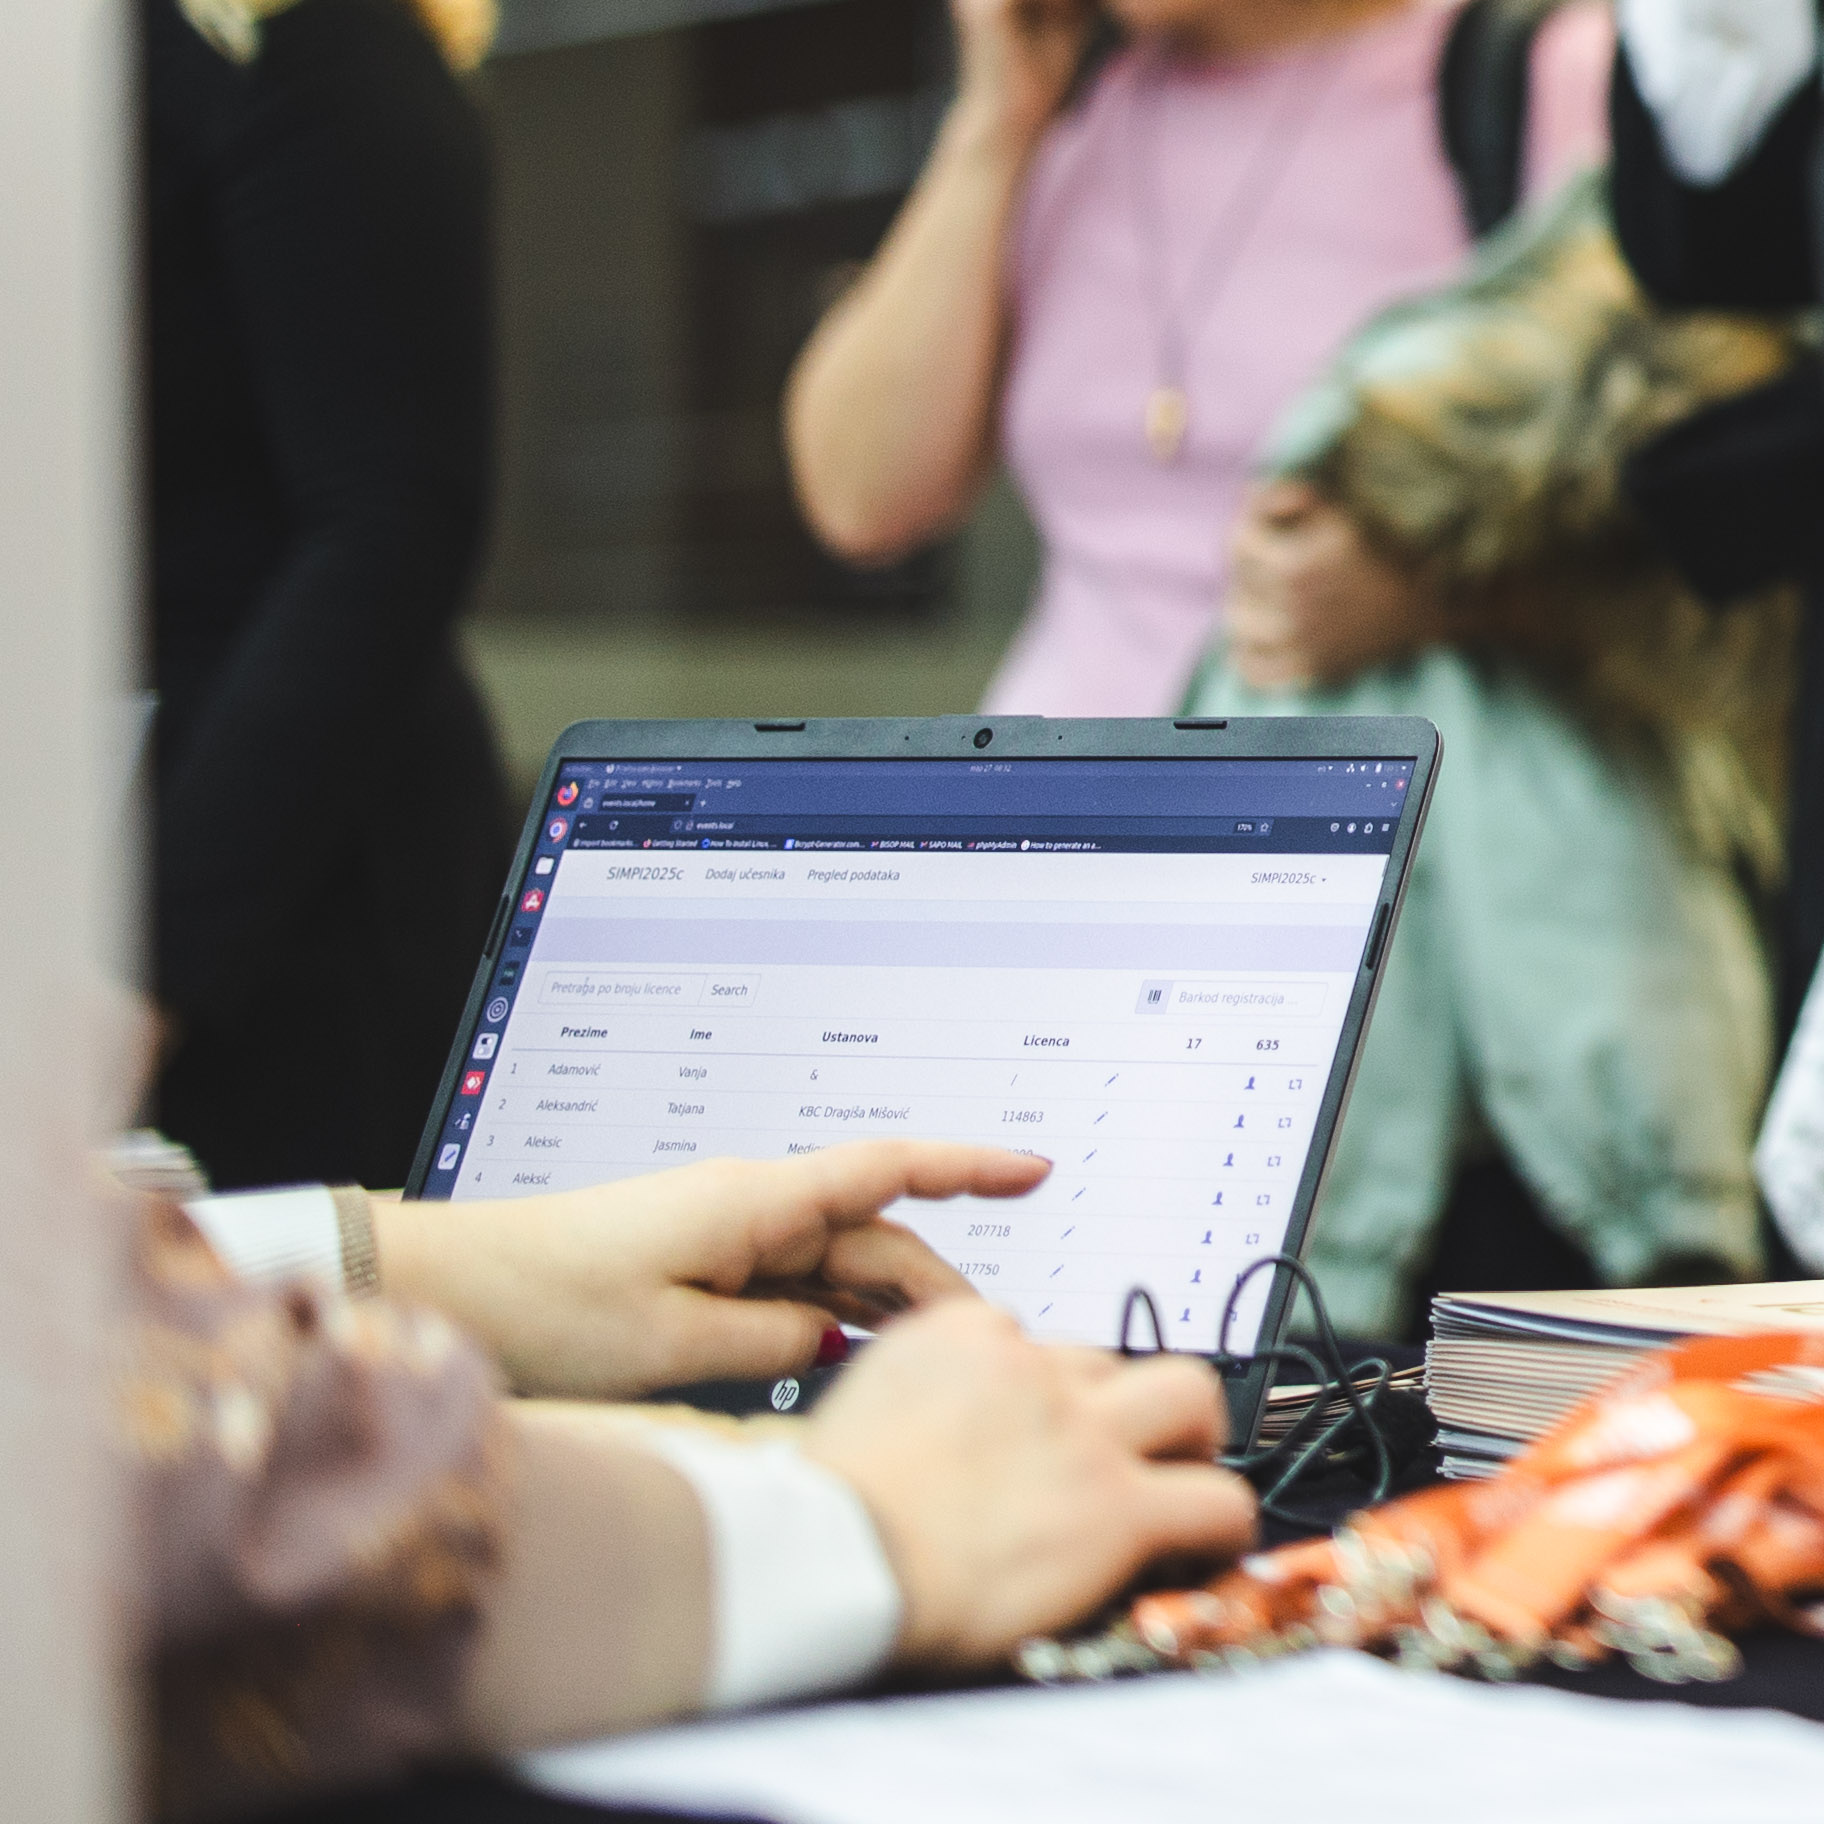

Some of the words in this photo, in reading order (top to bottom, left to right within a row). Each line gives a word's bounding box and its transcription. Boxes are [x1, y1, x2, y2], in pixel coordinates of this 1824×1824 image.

[605, 866, 685, 881] SIMPI2025c
[704, 868, 737, 882] Dodaj
[806, 868, 848, 883] Pregled
[849, 869, 901, 883] podataka
[1250, 872, 1317, 885] SIMPI2025c
[597, 984, 612, 998] po
[613, 981, 643, 998] broju
[643, 982, 682, 996] licence
[710, 983, 748, 997] Search
[1178, 991, 1219, 1004] Barkod
[1221, 992, 1285, 1007] registracija
[560, 1026, 609, 1039] Prezime
[689, 1029, 713, 1041] Ime
[821, 1031, 879, 1044] Ustanova
[1023, 1034, 1071, 1047] Licenca
[1186, 1038, 1203, 1049] 17
[1256, 1039, 1280, 1051] 635
[511, 1063, 518, 1075] 1
[678, 1066, 708, 1080] Vanja
[498, 1099, 507, 1110] 2
[667, 1102, 705, 1116] Tatjana
[799, 1105, 822, 1118] KBC
[1001, 1110, 1044, 1123] 114863
[486, 1135, 495, 1147] 3
[653, 1139, 698, 1153] Jasmina
[474, 1171, 482, 1183] 4
[967, 1223, 1012, 1238] 207718
[773, 1378, 798, 1410] hp
